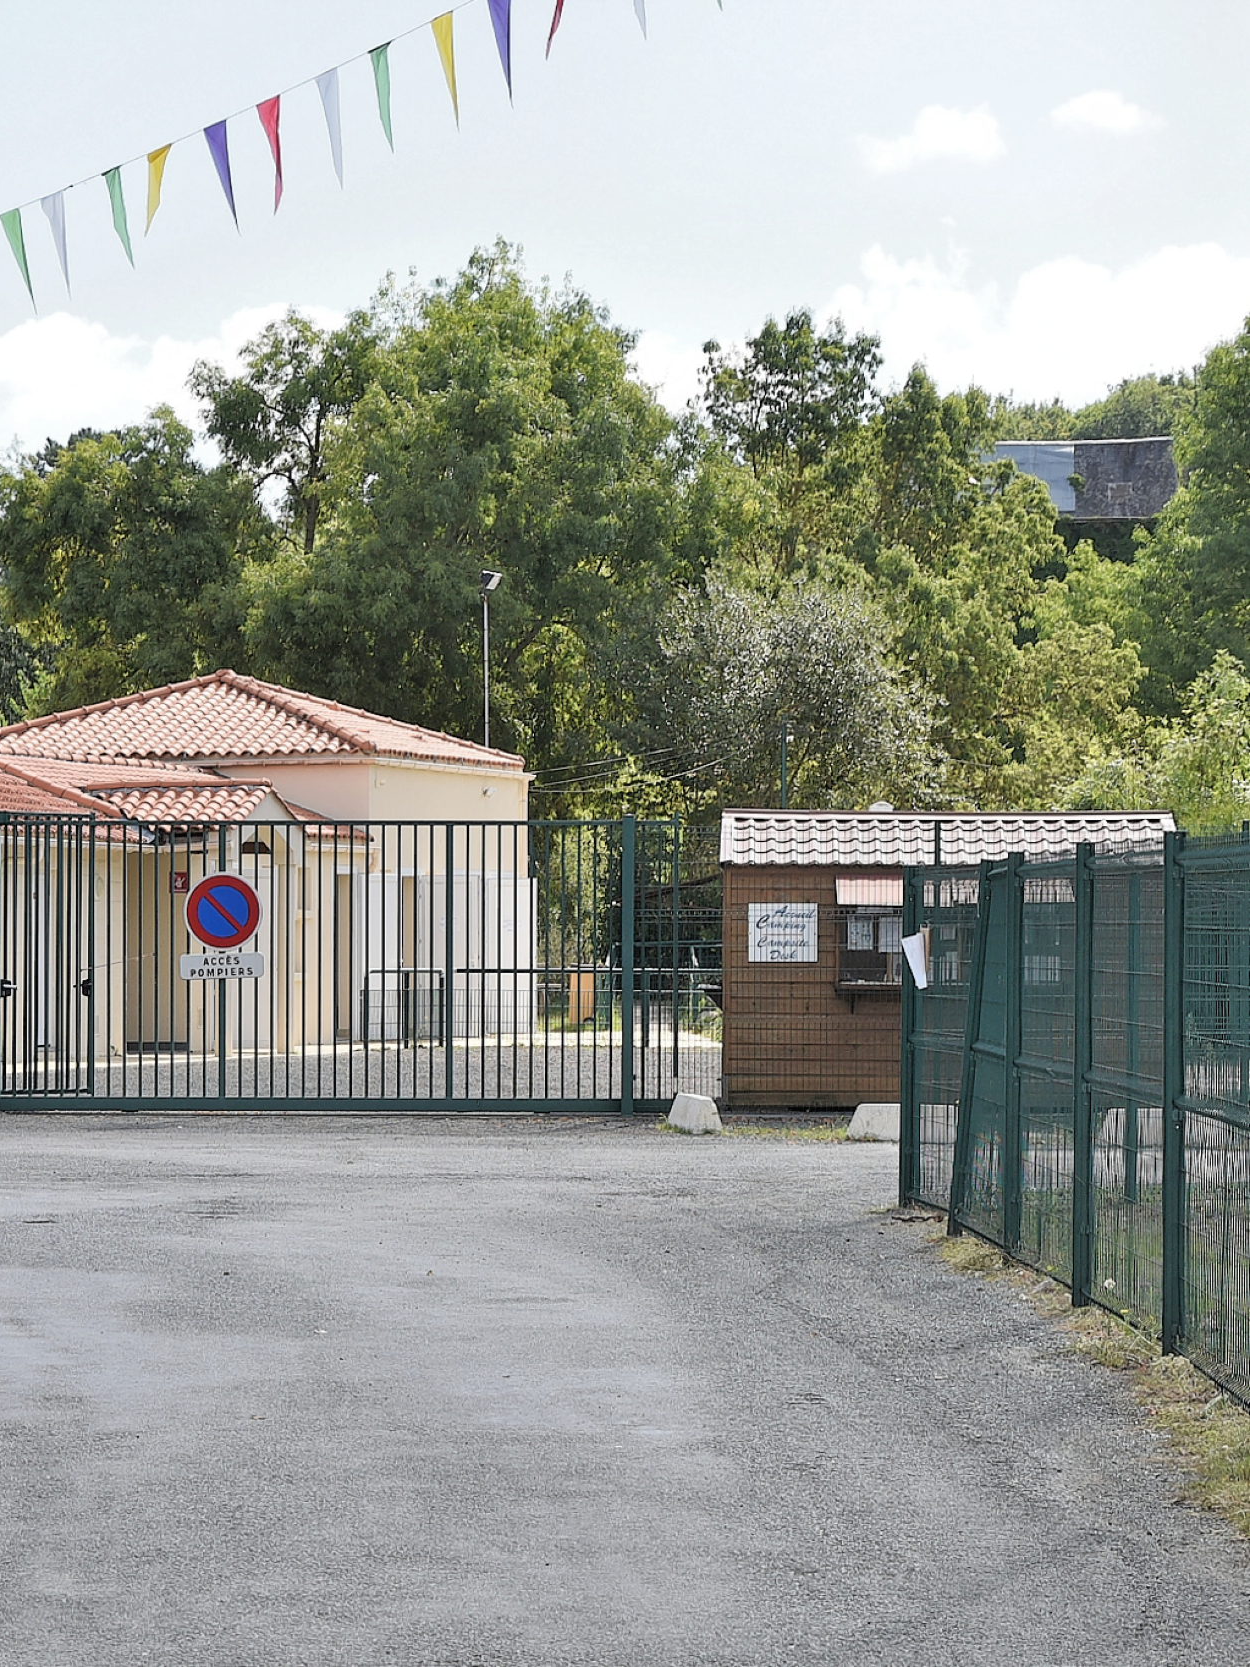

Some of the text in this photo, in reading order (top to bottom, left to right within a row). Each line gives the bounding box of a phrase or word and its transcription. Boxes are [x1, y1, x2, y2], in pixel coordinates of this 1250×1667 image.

[772, 905, 816, 918] Accueil
[756, 914, 806, 931] Camping
[757, 936, 809, 948] Campsite
[203, 955, 240, 966] ACCÈS
[770, 950, 797, 960] Desk
[190, 967, 254, 977] POMPIERS
